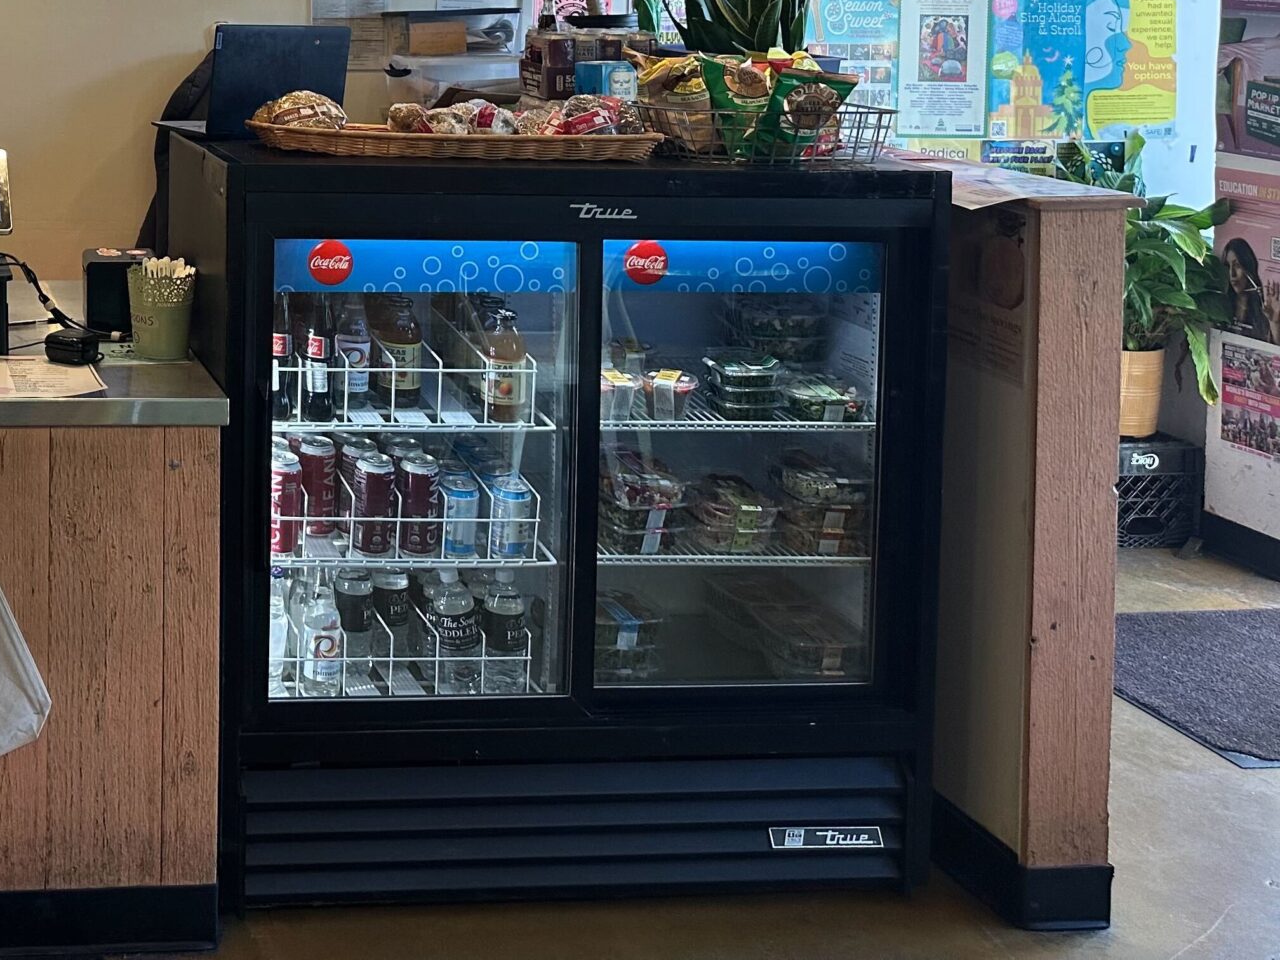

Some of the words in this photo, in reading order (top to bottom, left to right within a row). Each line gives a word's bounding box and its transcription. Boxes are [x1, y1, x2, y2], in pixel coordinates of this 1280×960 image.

[1038, 2, 1081, 14] Holiday
[843, 13, 885, 29] Sweet
[1020, 13, 1046, 24] Sing
[1048, 13, 1081, 24] Along
[1038, 25, 1047, 35] &
[1050, 25, 1081, 35] Stroll
[1128, 62, 1147, 71] You
[1149, 62, 1172, 70] have
[1134, 71, 1172, 80] options.
[1251, 89, 1267, 99] POP
[921, 147, 968, 159] Radical
[1219, 180, 1257, 196] EDUCATION
[570, 203, 638, 220] true
[310, 255, 351, 269] Coca-Cola
[626, 255, 666, 270] Coca-Cola
[440, 618, 457, 628] The
[816, 830, 874, 844] true
